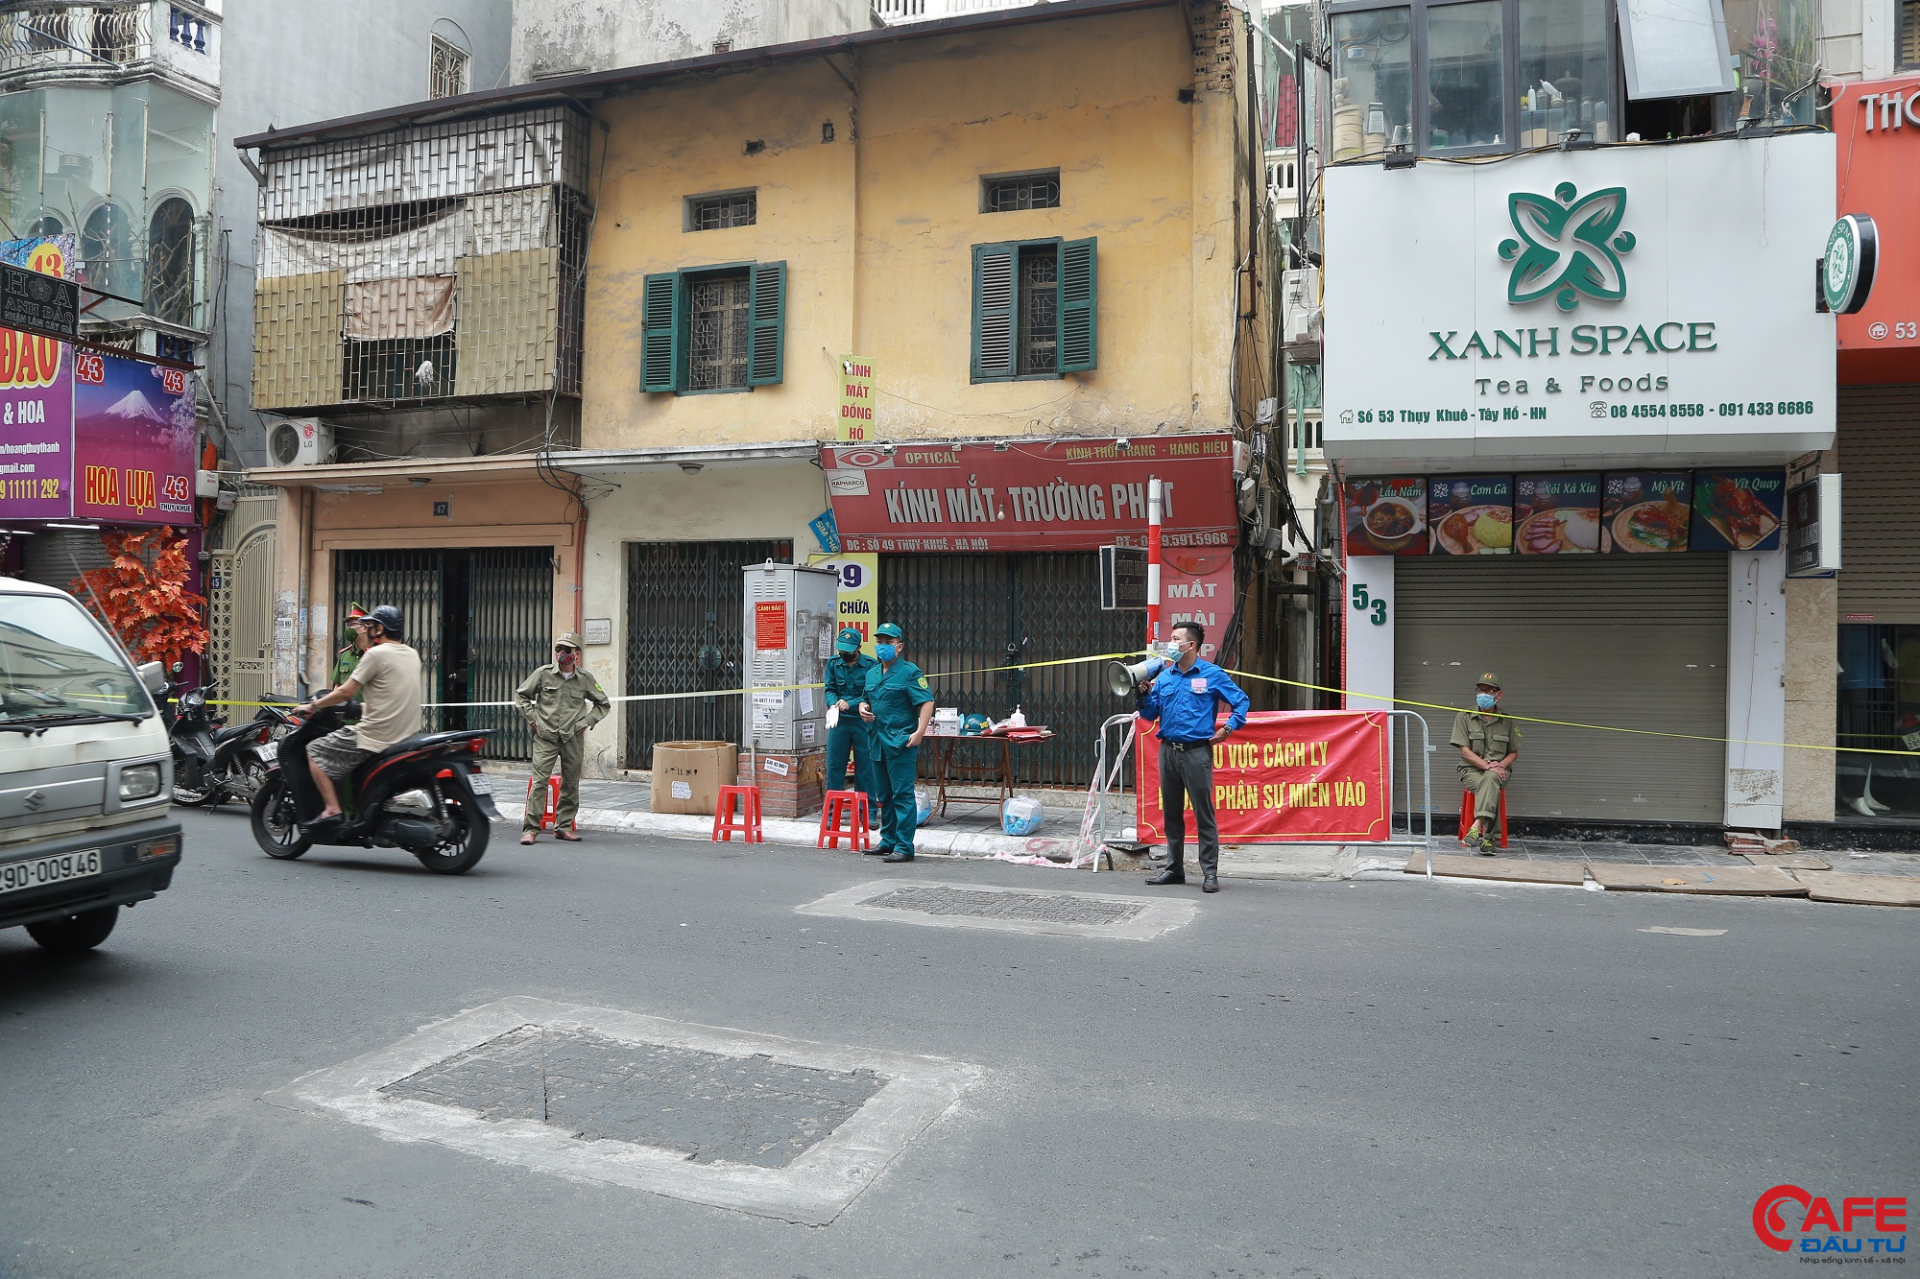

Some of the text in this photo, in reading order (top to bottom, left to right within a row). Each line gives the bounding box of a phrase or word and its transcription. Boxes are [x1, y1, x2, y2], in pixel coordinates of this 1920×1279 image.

[5, 296, 40, 316] ANH
[1894, 322, 1917, 339] 53
[1428, 322, 1718, 360] XANH SPACE
[76, 355, 104, 383] 43
[164, 370, 184, 393] 43
[846, 382, 869, 398] MẮT
[1475, 373, 1669, 395] Tea & Foods
[4, 400, 45, 424] & HOA
[842, 402, 872, 420] ĐỒNG
[1358, 409, 1374, 423] Số
[1378, 410, 1395, 422] 53
[1400, 410, 1430, 424] Thụy
[1436, 408, 1468, 422] Khuê
[1478, 408, 1499, 422] Tây
[1503, 406, 1520, 420] Hồ
[1530, 407, 1546, 420] HN
[1610, 405, 1628, 418] 08
[1632, 404, 1666, 418] 4554
[1670, 404, 1704, 417] 8558
[1719, 403, 1744, 416] 091
[1748, 402, 1774, 416] 433
[1778, 401, 1814, 415] 6686
[849, 424, 864, 440] HỒ
[905, 452, 960, 464] OPTICAL
[1066, 446, 1092, 460] KÍNH
[1170, 442, 1200, 456] HÀNG
[1203, 440, 1228, 456] HIỆU
[9, 480, 37, 499] 11111
[40, 478, 60, 498] 292
[85, 465, 156, 515] HOA LỤA
[163, 475, 188, 500] 43
[1470, 484, 1507, 496] Cơm Gà
[1544, 483, 1561, 494] Xôi
[1563, 482, 1576, 494] Xá
[1652, 480, 1686, 494] Mỳ Vịt
[1734, 478, 1780, 490] Vịt Quay
[884, 481, 942, 523] KÍNH
[945, 474, 996, 522] MẮT
[1008, 477, 1106, 522] TRƯỜNG
[436, 504, 446, 514] 47
[815, 520, 828, 538] SIM
[882, 540, 894, 550] 49
[898, 539, 920, 552] THỤY
[956, 538, 968, 550] HÀ
[1168, 579, 1218, 598] MẮT
[840, 599, 870, 614] CHỮA
[1352, 584, 1386, 626] 53
[1228, 742, 1258, 773] VỰC
[1263, 738, 1306, 768] CÁCH
[1310, 742, 1329, 766] LY
[1216, 780, 1258, 815] PHẬN
[1263, 782, 1286, 814] SỰ
[1288, 774, 1330, 808] MIỄN
[1334, 776, 1366, 807] VÀO
